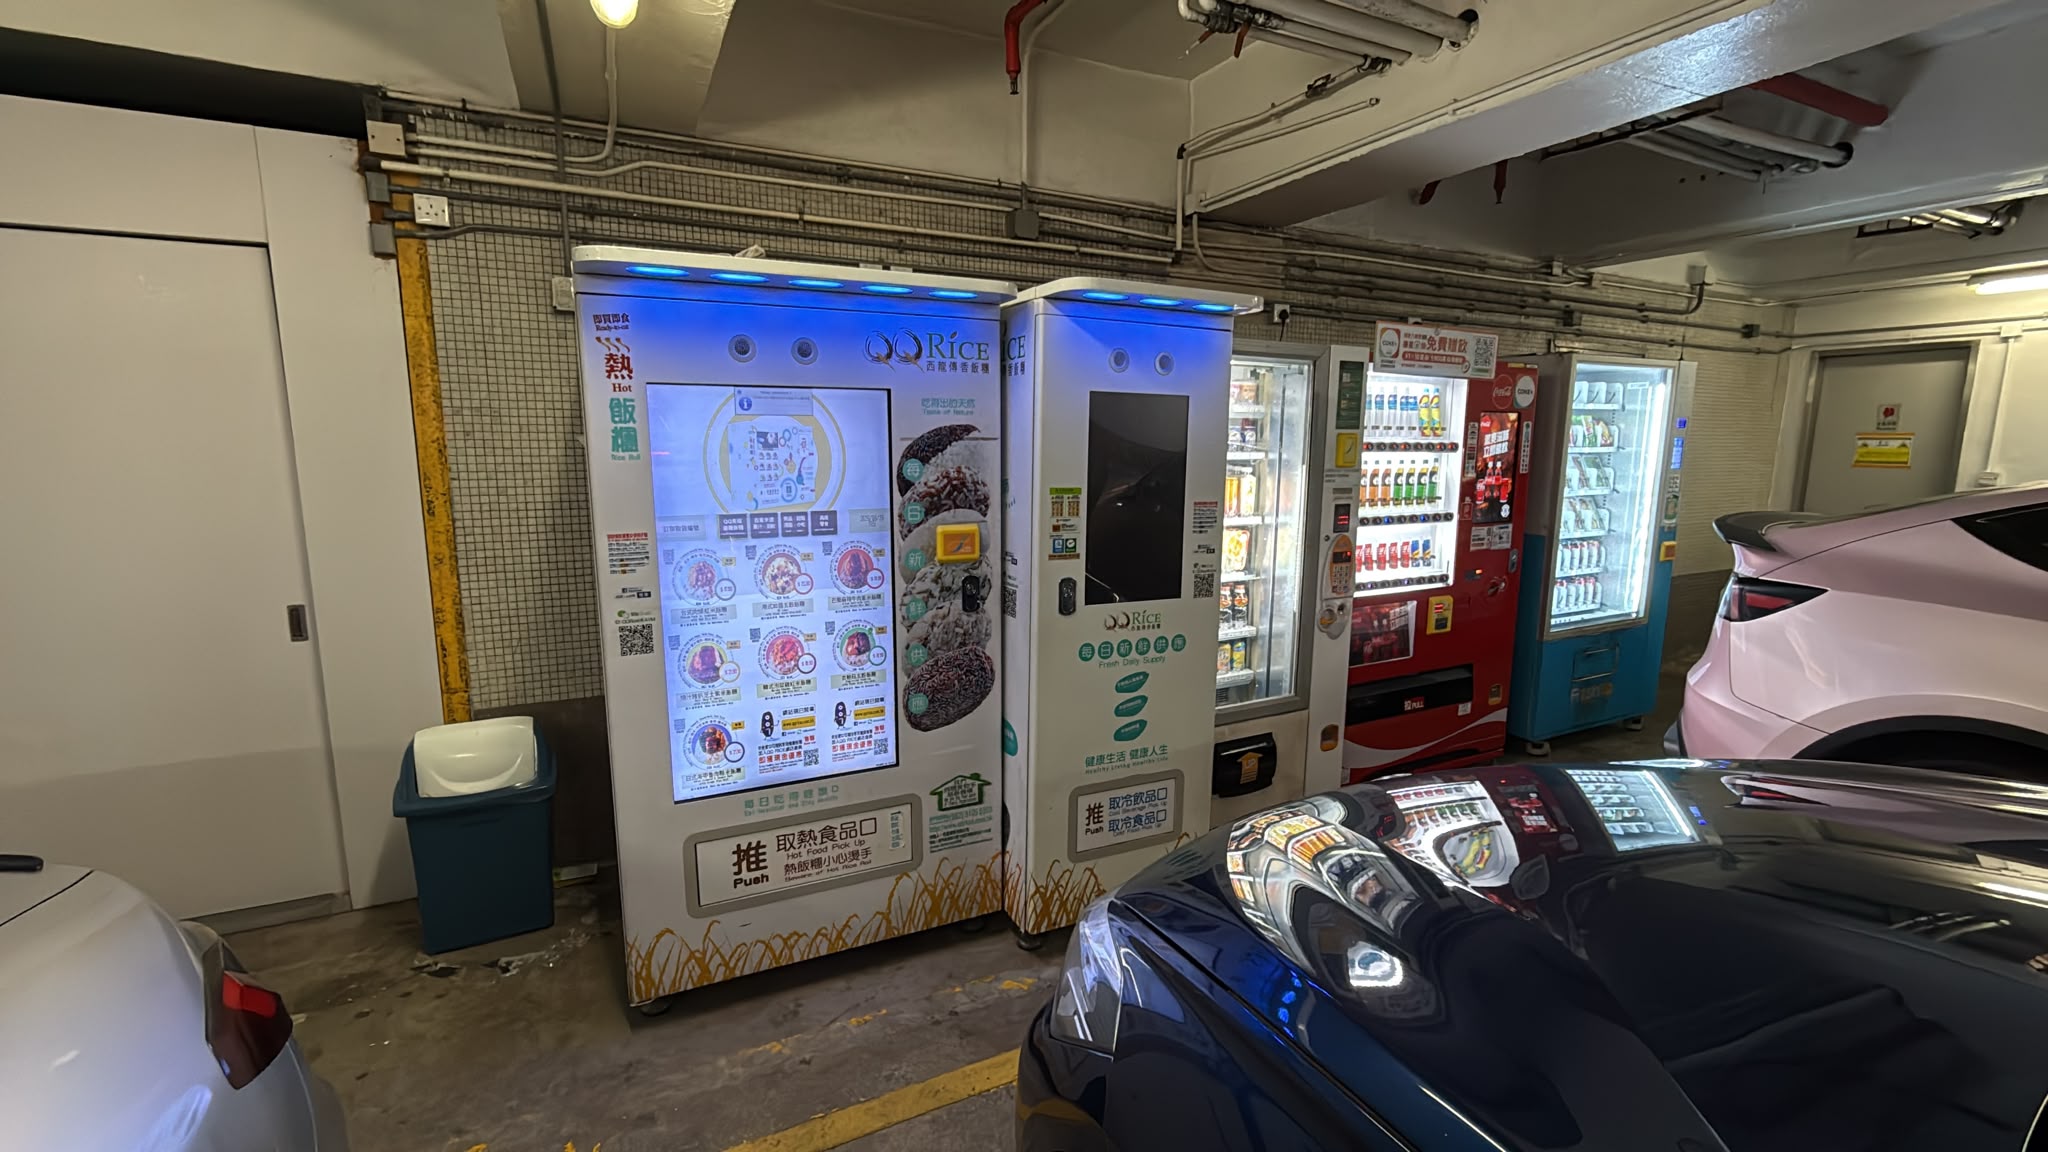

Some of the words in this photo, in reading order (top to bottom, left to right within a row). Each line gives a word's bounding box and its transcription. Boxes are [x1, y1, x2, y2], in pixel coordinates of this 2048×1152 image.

[593, 313, 630, 324] 即買即食
[604, 353, 633, 380] 熱
[612, 383, 632, 392] Hot
[1085, 751, 1126, 768] 健康生活
[1129, 744, 1168, 762] 健康人生
[1109, 788, 1168, 810] 取冷飲品口
[1085, 802, 1104, 826] 推
[1108, 809, 1167, 832] 取冷食品口
[776, 818, 877, 852] 取熱食品口
[1085, 827, 1104, 836] Push
[732, 840, 768, 876] 推
[787, 851, 803, 860] Hot
[807, 846, 828, 857] Food
[832, 840, 850, 850] Pick
[854, 838, 866, 848] Up
[734, 874, 769, 888] Push
